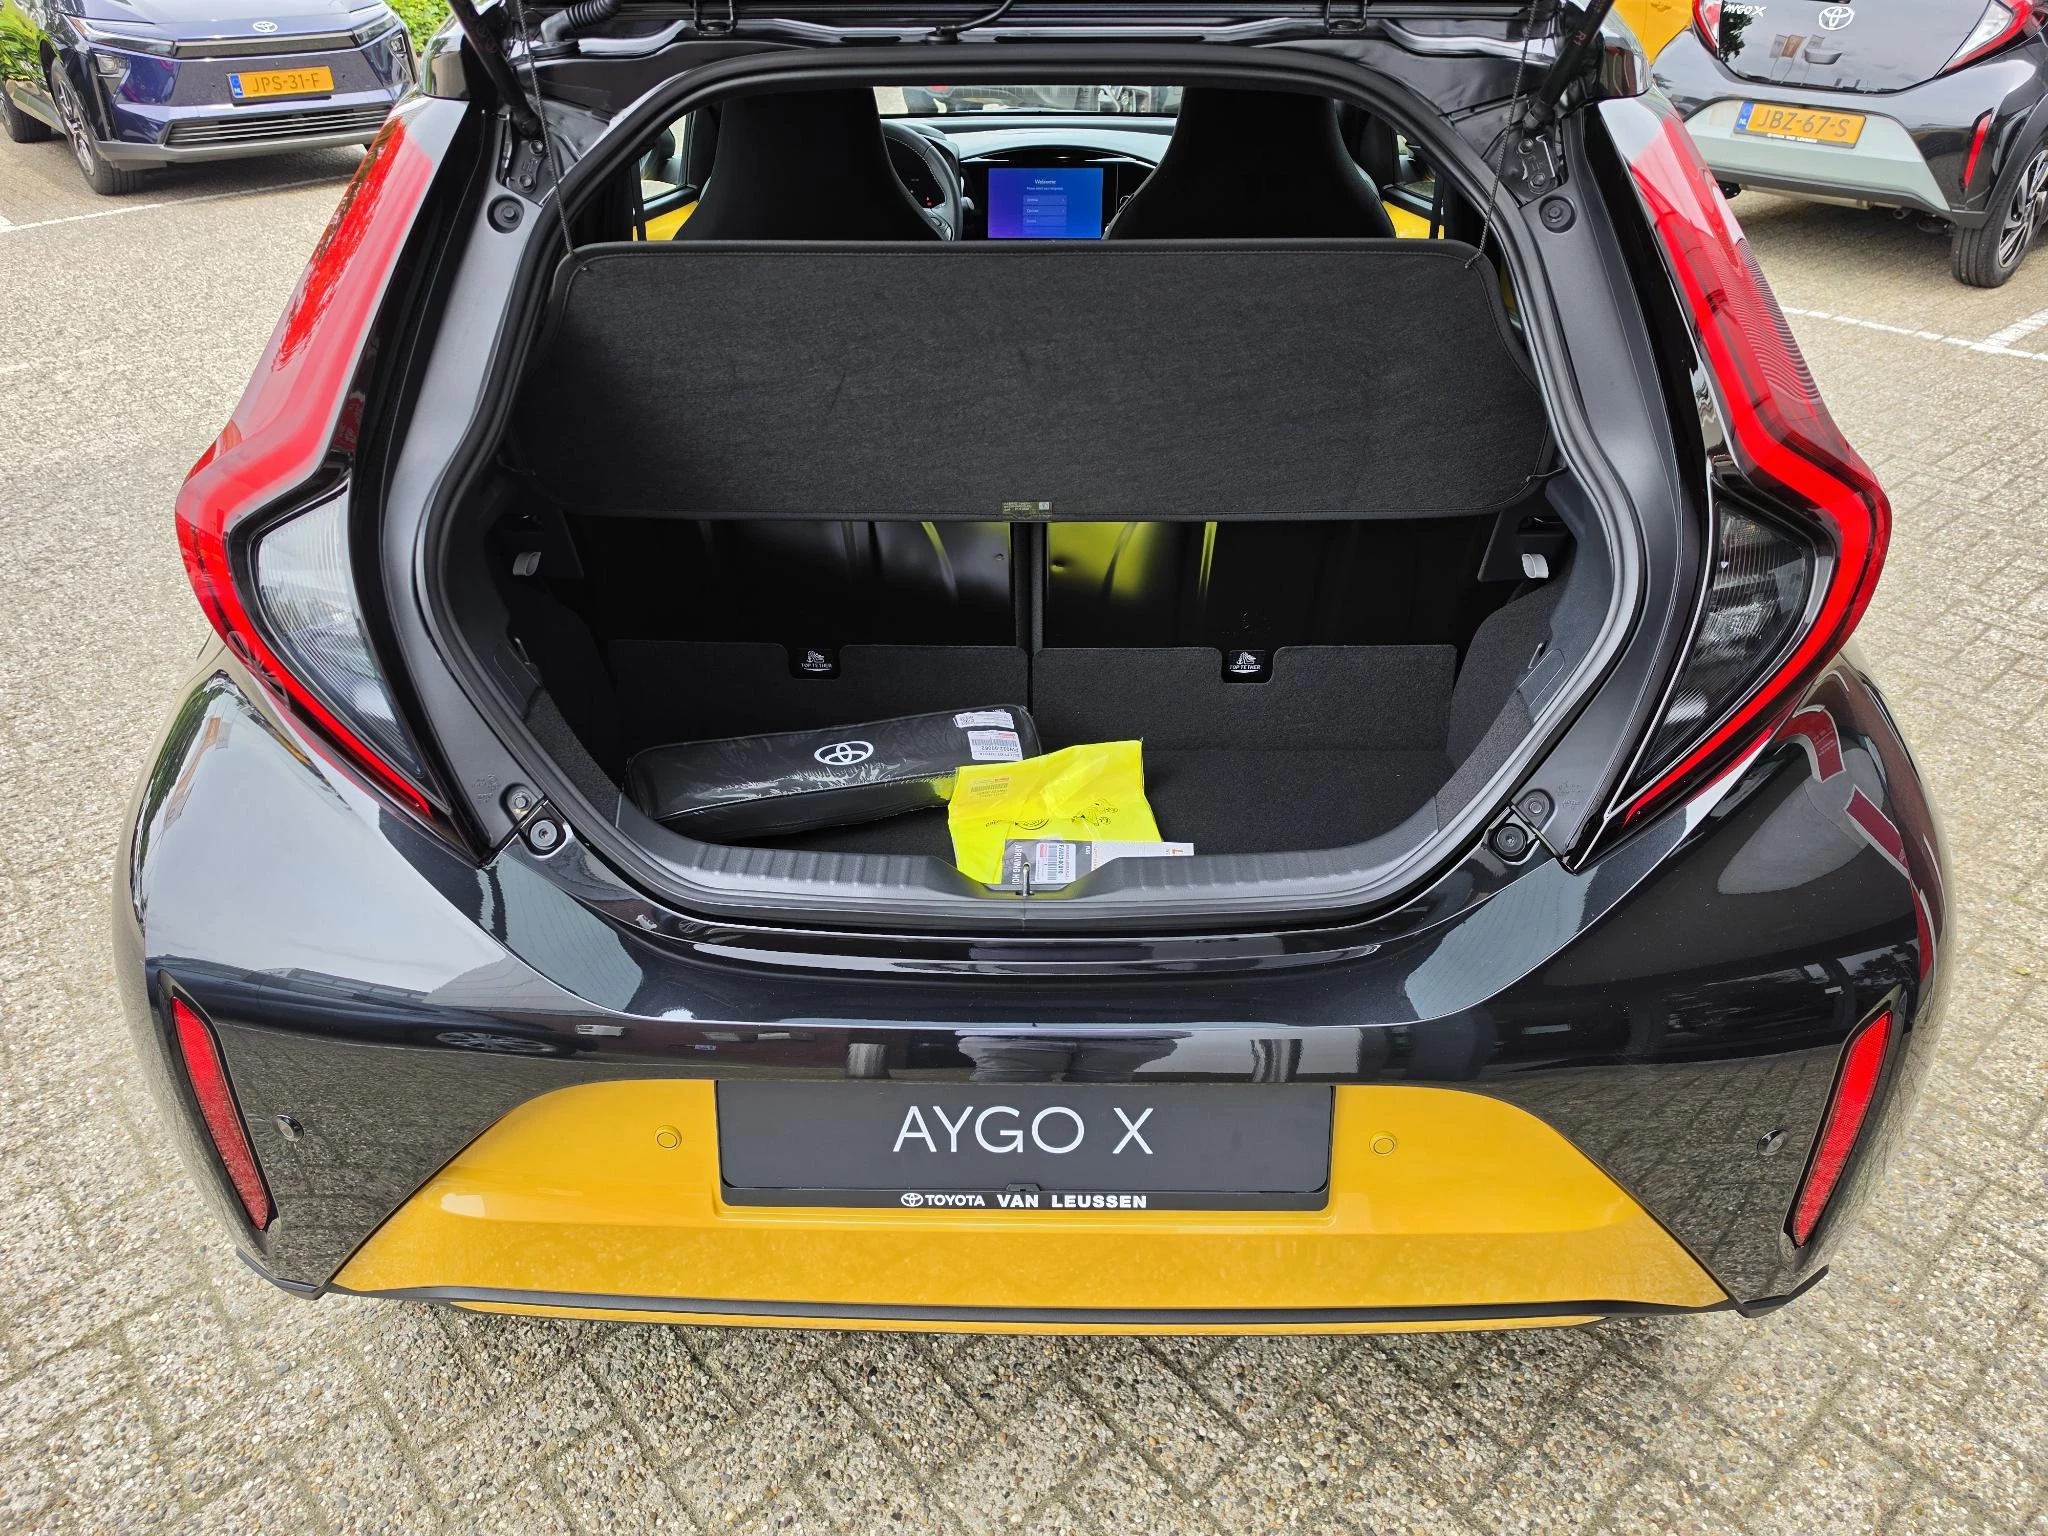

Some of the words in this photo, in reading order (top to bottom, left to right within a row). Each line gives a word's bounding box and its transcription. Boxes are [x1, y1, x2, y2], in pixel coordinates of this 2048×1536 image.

[253, 73, 320, 92] JPS-31-F
[1758, 109, 1850, 137] JBZ-67-S
[1012, 844, 1022, 873] ARRIVING
[893, 1105, 1085, 1154] AYGO
[1112, 1107, 1154, 1155] X
[925, 1193, 986, 1207] TOYOTA
[996, 1193, 1040, 1208] VAN
[1051, 1194, 1147, 1209] LEUSSEN
